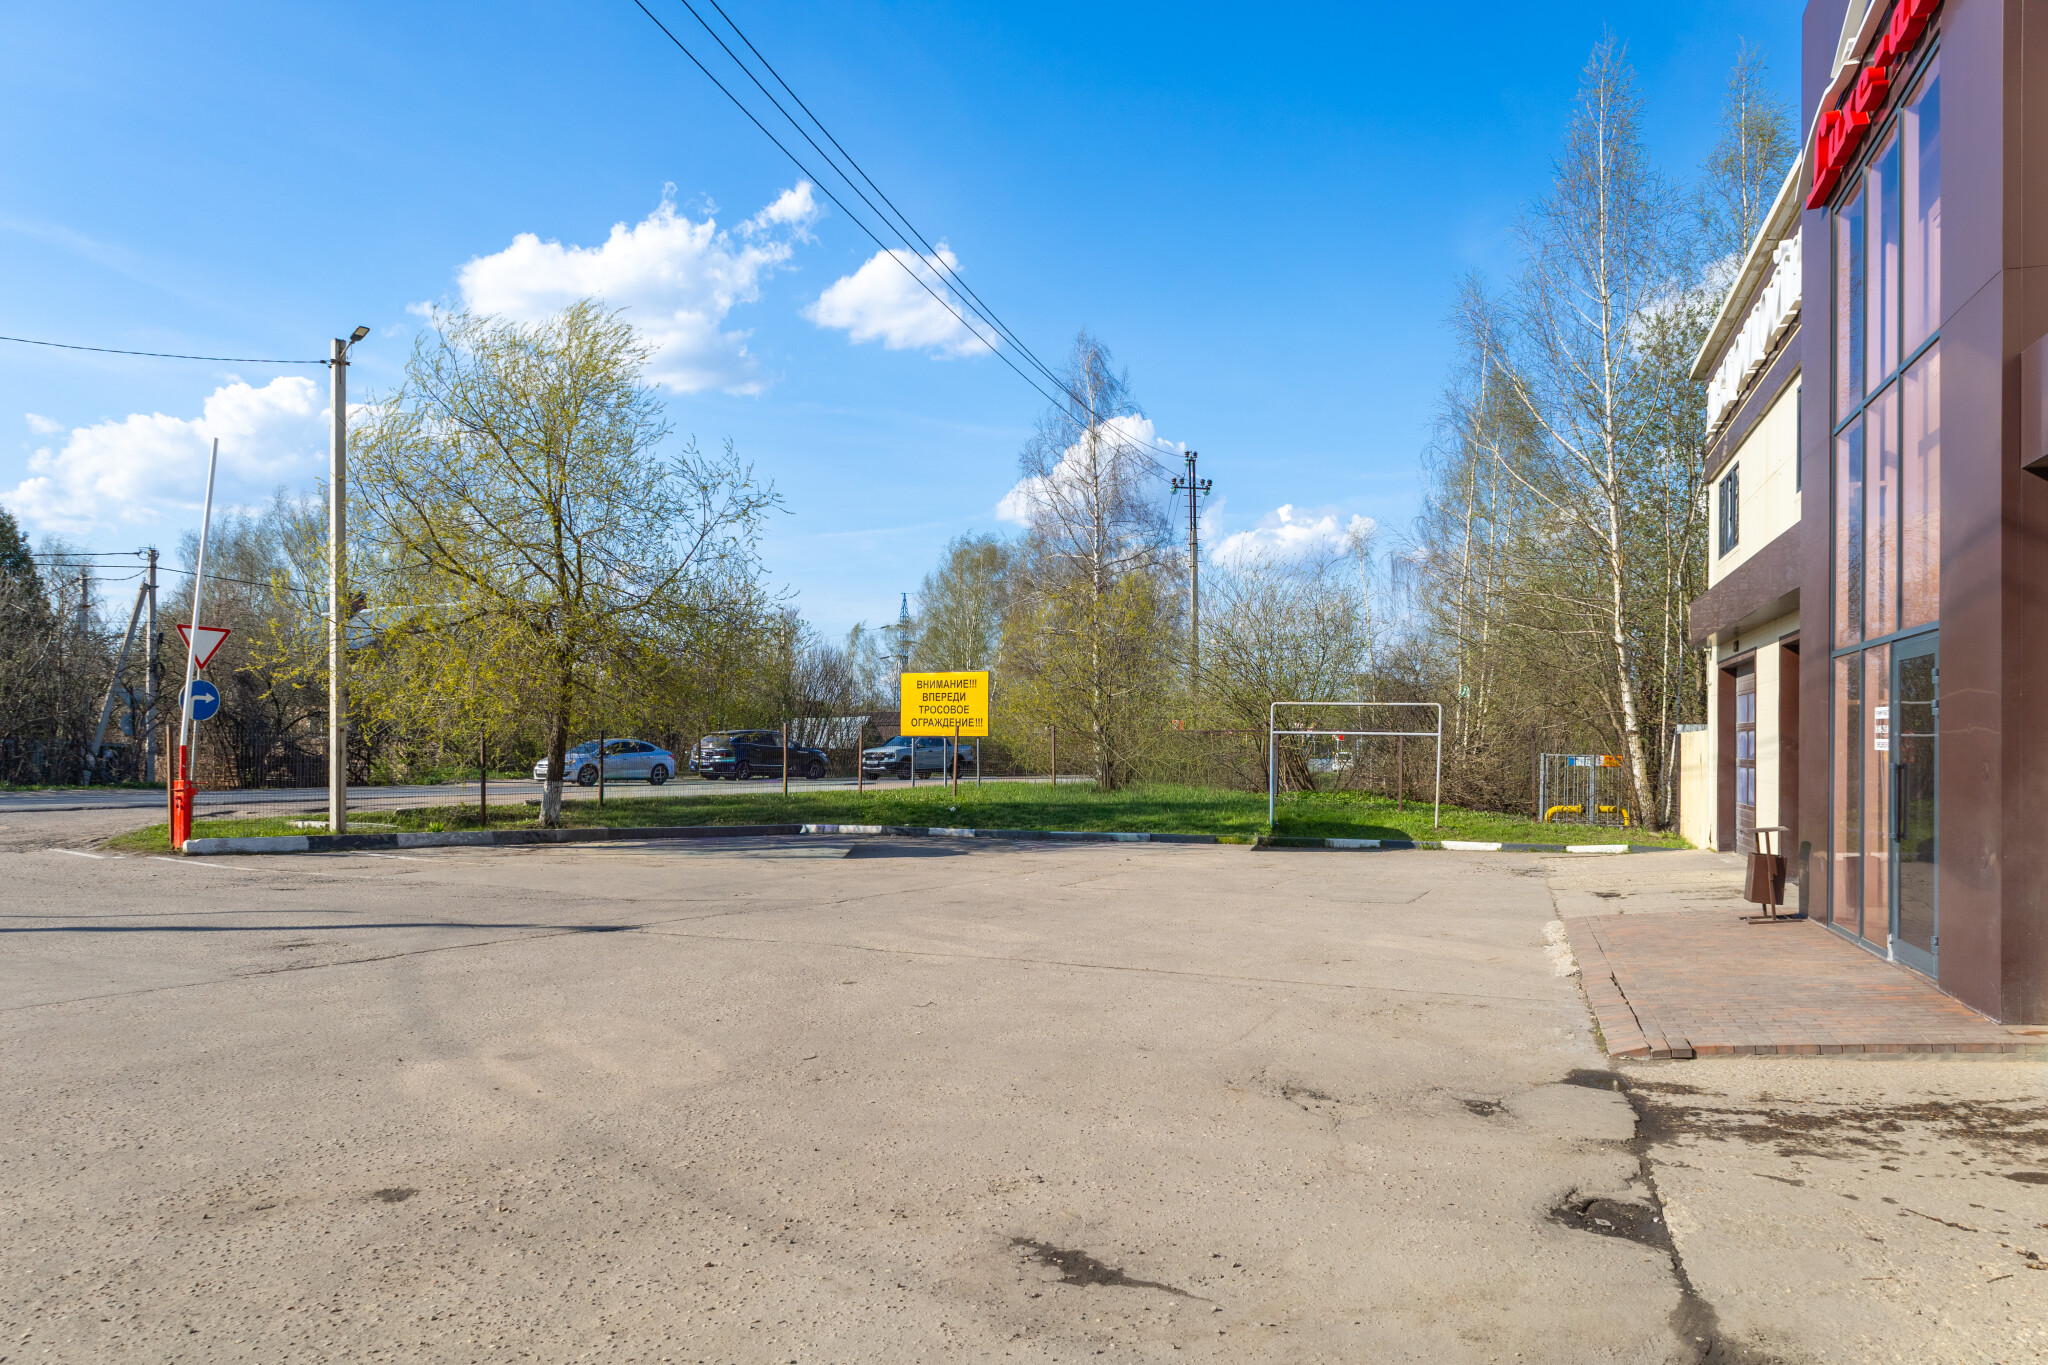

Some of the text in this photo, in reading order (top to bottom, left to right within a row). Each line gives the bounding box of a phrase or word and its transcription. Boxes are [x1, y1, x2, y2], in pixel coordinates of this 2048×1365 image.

[1806, 0, 1938, 210] Luxe-a
[916, 679, 977, 689] ВНИМАНИЕ!!!
[922, 692, 966, 703] ВПЕРЕДИ
[919, 705, 970, 714] ТРОСОВОЕ
[911, 718, 983, 728] ОГРАЖДЕНИЕ!!!
